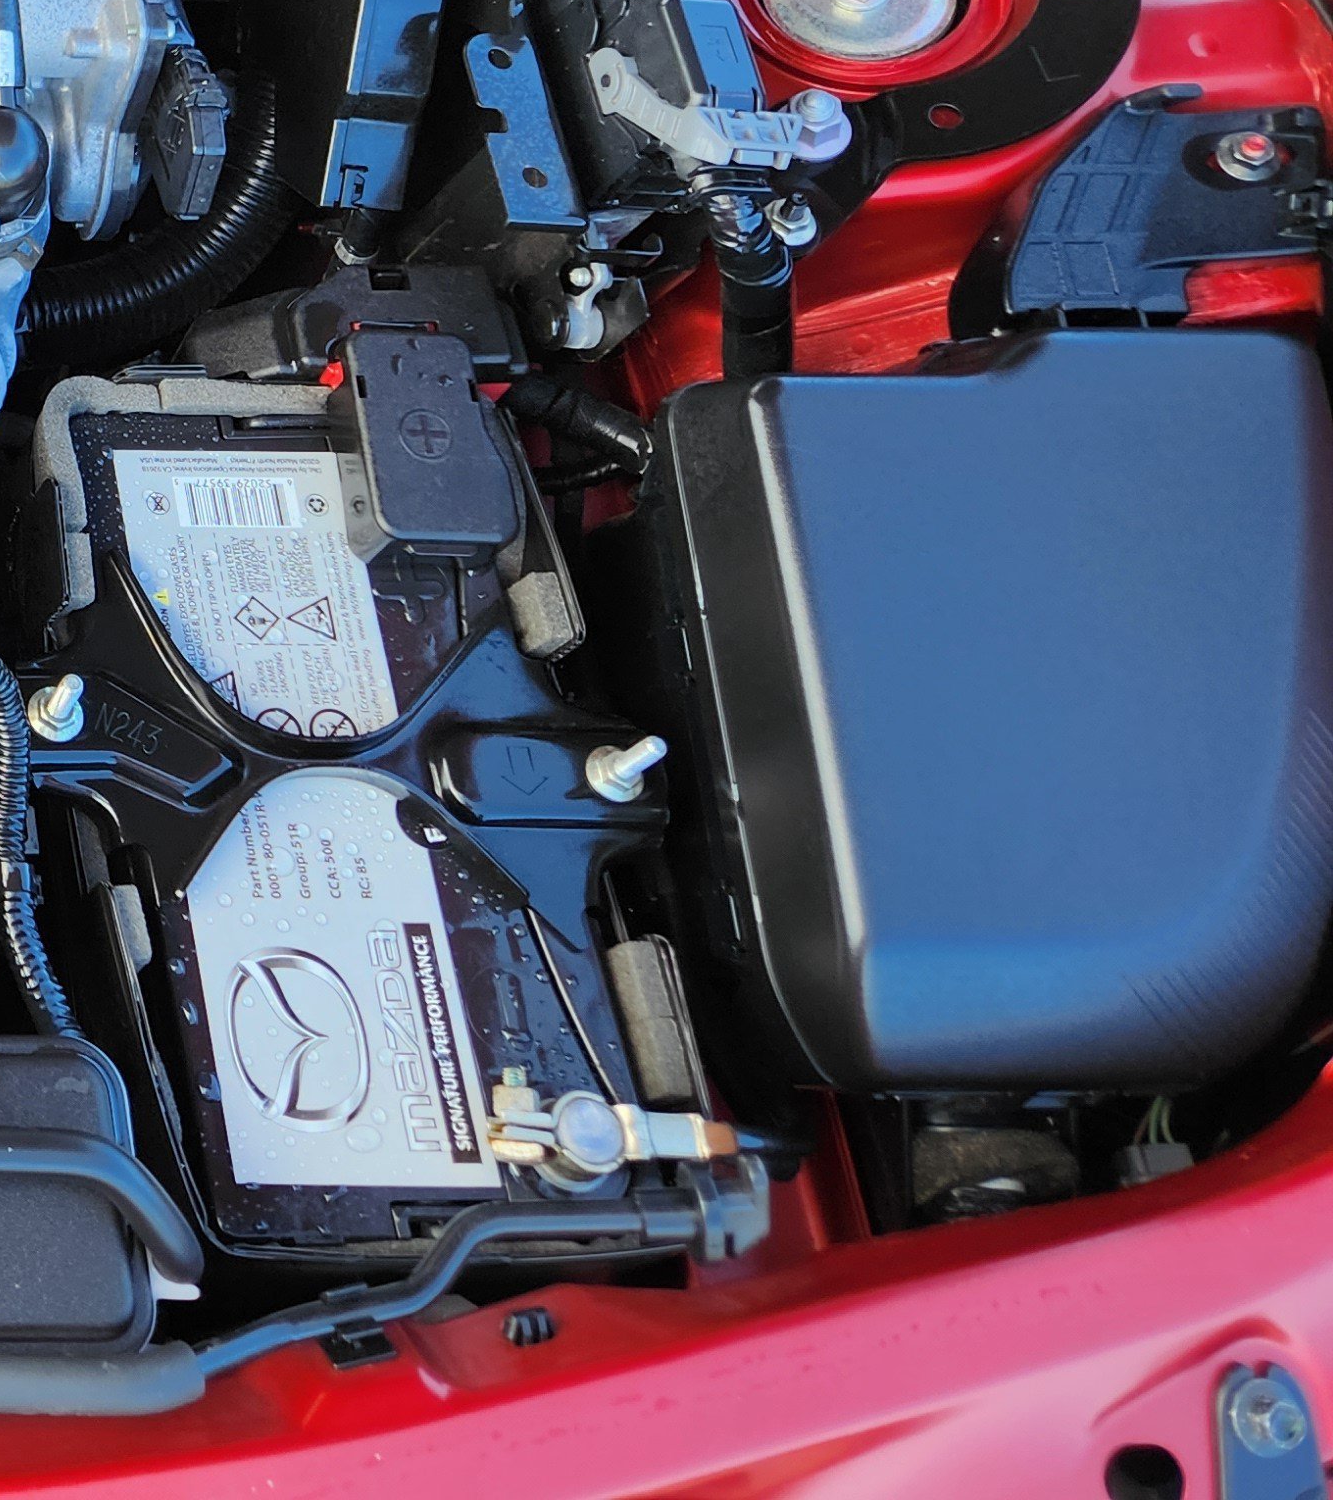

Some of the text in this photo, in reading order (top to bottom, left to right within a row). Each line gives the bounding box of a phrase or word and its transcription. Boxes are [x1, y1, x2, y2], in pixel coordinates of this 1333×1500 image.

[212, 607, 221, 625] NOT
[193, 629, 205, 657] CAUSE
[94, 702, 163, 755] N243
[252, 869, 263, 898] Part
[287, 822, 312, 899] Group: 51R
[321, 839, 341, 899] CCA: 500
[357, 858, 375, 900] RC: 85
[416, 935, 474, 1152] SIGNATURE PERFORMANCE
